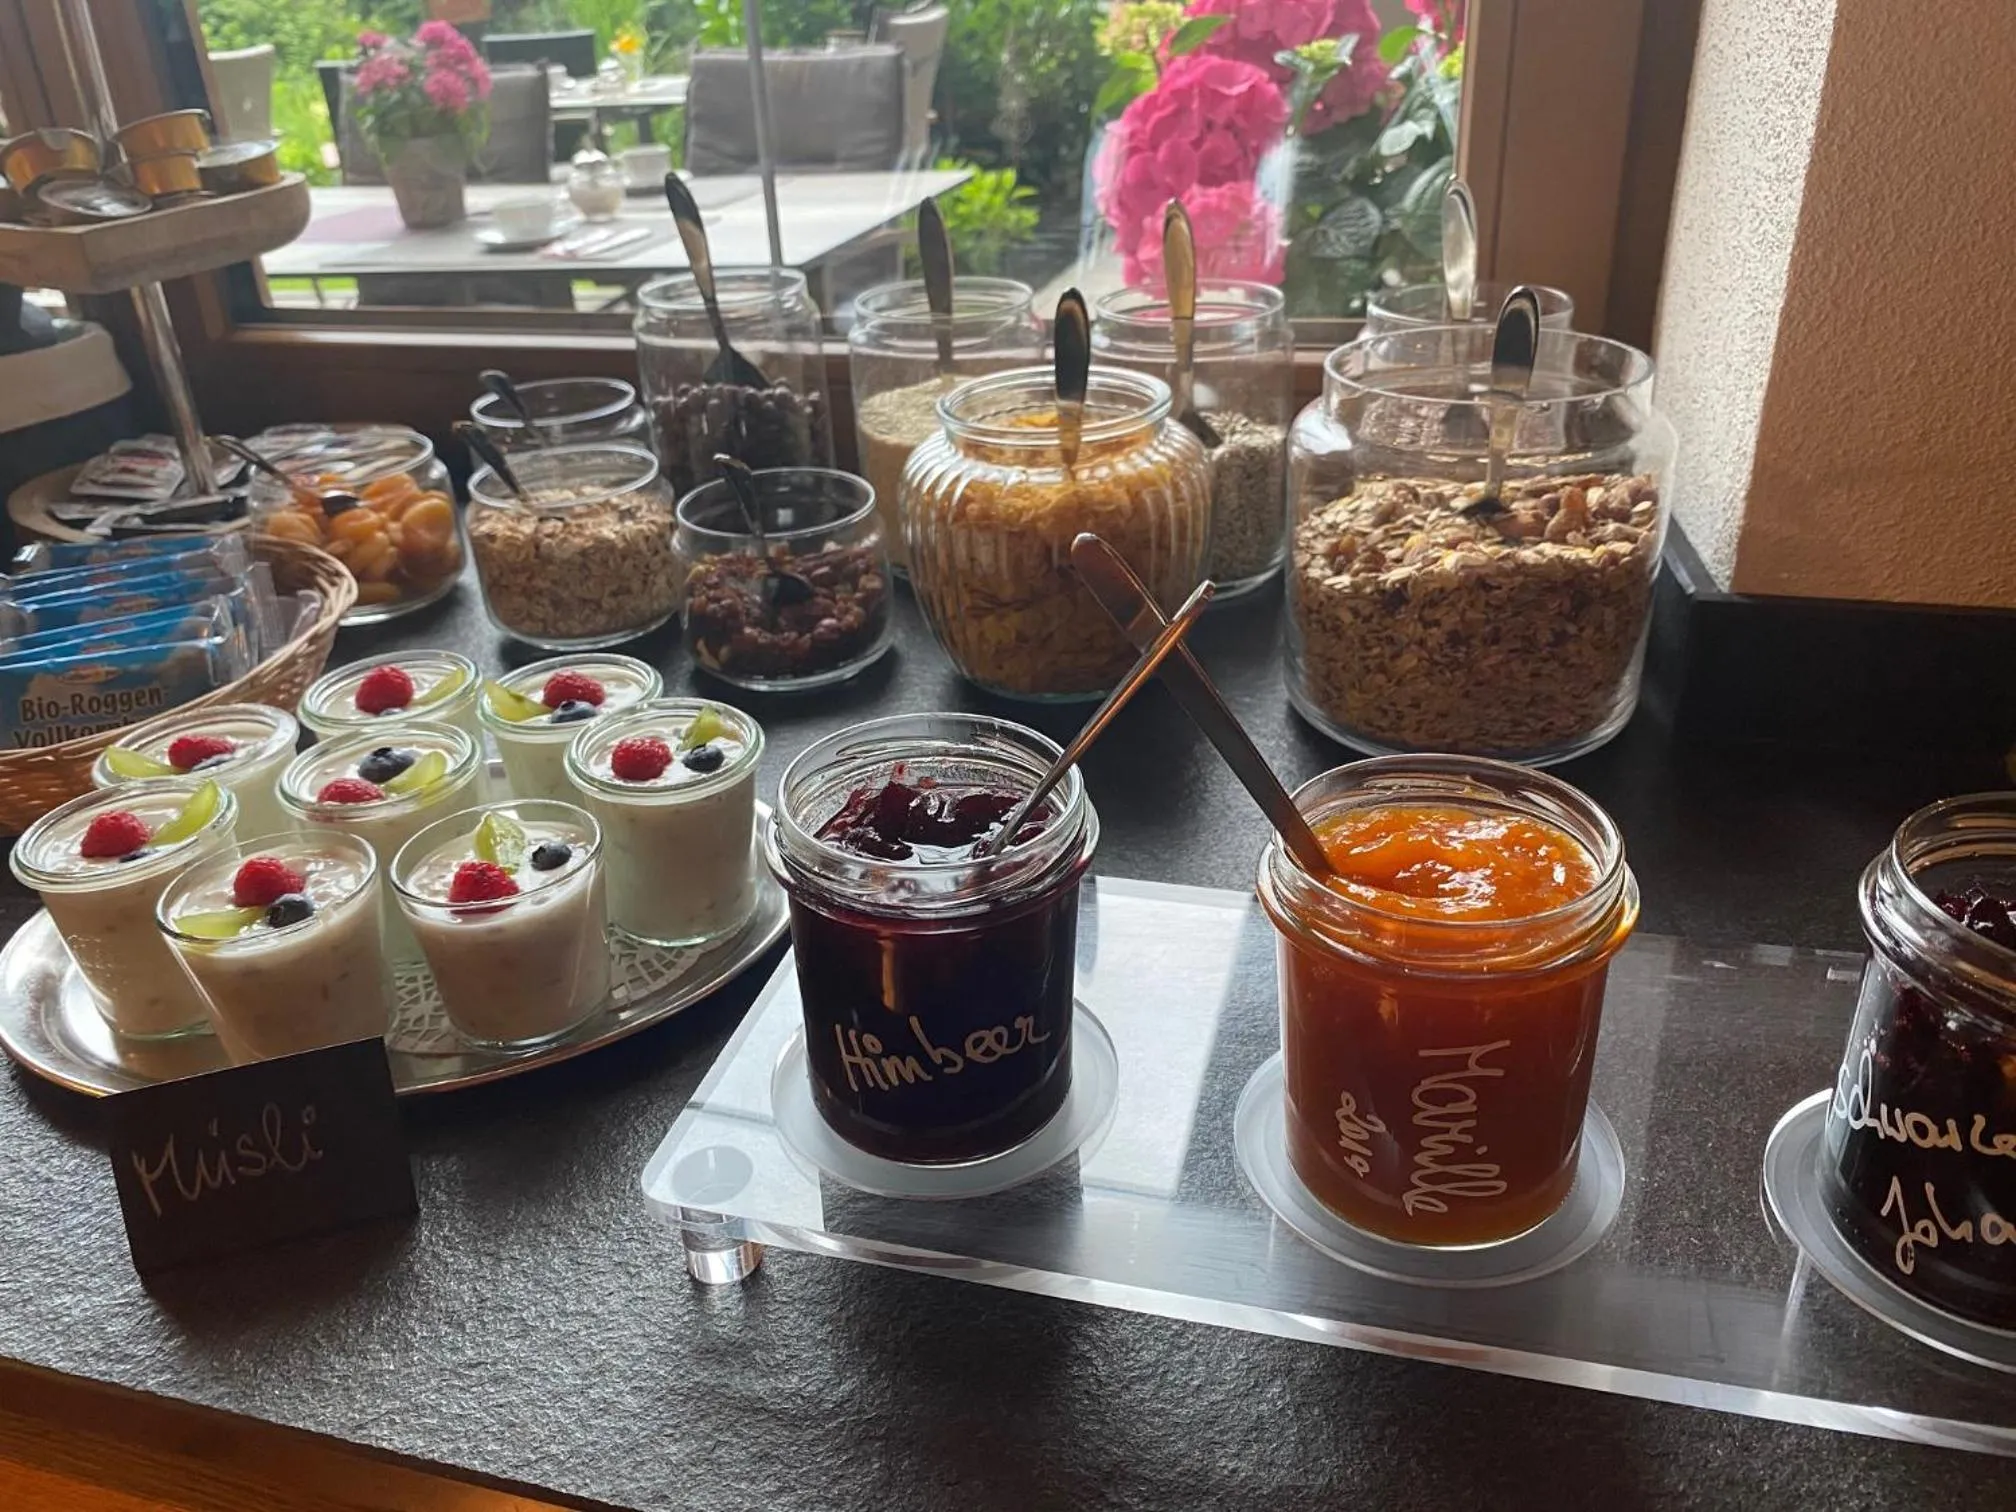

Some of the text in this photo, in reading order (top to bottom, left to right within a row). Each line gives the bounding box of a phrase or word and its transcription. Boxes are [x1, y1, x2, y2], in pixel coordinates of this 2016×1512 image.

[834, 1014, 1051, 1092] Himbeer
[131, 1102, 324, 1218] Müsli
[1402, 1039, 1511, 1217] Marille
